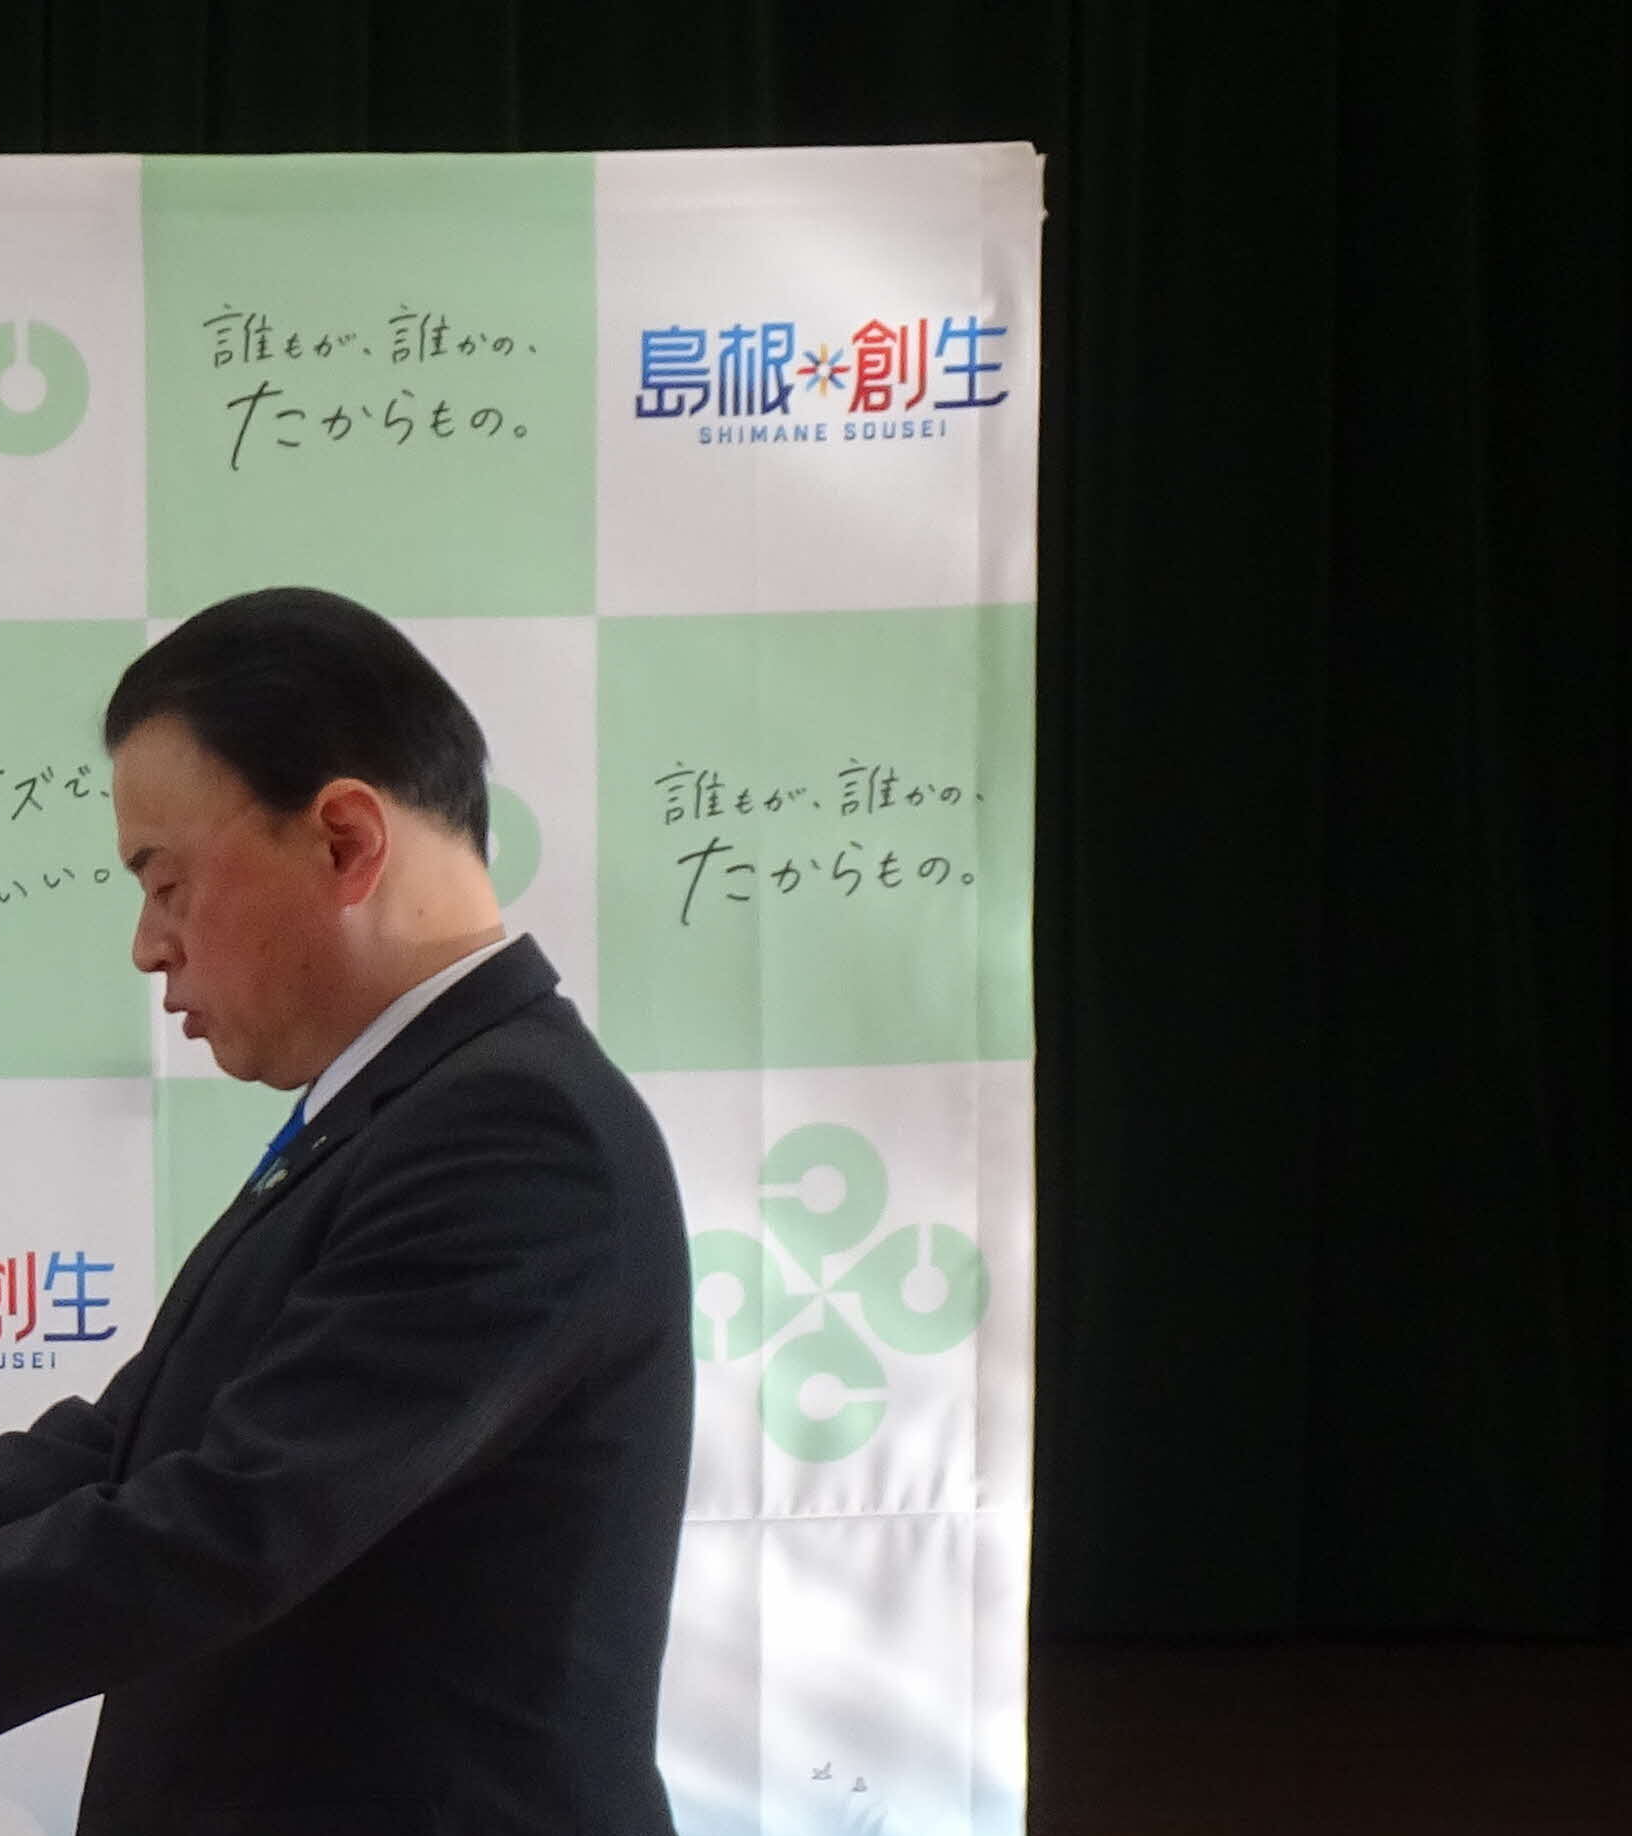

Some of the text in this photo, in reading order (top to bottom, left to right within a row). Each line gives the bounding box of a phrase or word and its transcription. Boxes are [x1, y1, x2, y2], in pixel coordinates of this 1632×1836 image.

[203, 304, 536, 368] 誰もが、誰かの、
[226, 380, 527, 472] たからもの。
[699, 419, 946, 445] SHIMANE SOUSEI
[654, 758, 985, 825] 誰もが、誰かの、
[677, 837, 978, 927] たからもの。
